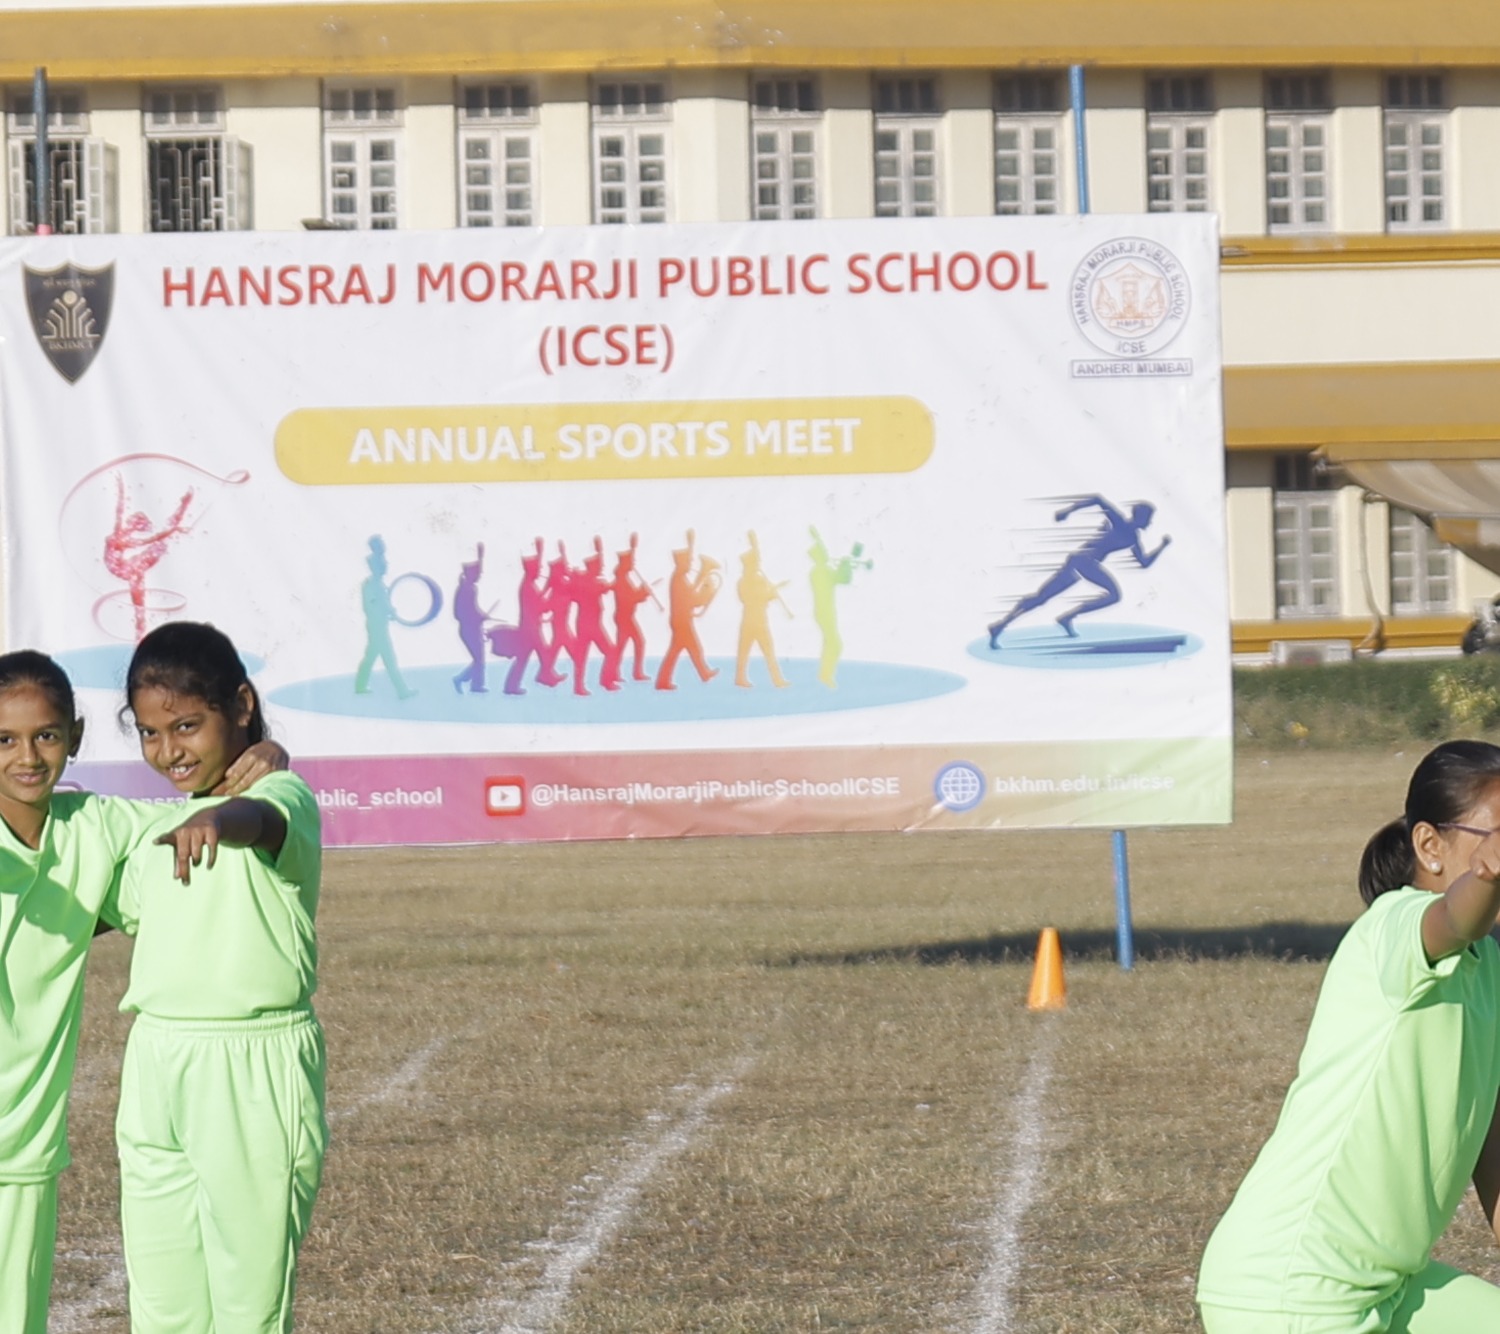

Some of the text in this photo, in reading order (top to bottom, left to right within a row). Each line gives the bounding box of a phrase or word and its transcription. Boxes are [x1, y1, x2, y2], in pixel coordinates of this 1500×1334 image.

[162, 250, 1048, 307] HANSRAJ MORARJI PUBLIC SCHOOL
[1074, 242, 1186, 324] HANSRAJ MORARJI PUBLIC SCHOOL
[538, 324, 674, 373] (ICSE)
[1076, 362, 1189, 374] ANDHERI MUMBAI
[1117, 340, 1147, 353] ICSE
[349, 417, 862, 464] ANNUAL SPORTS MEET
[994, 774, 1175, 794] bkhm.edu.in/icse
